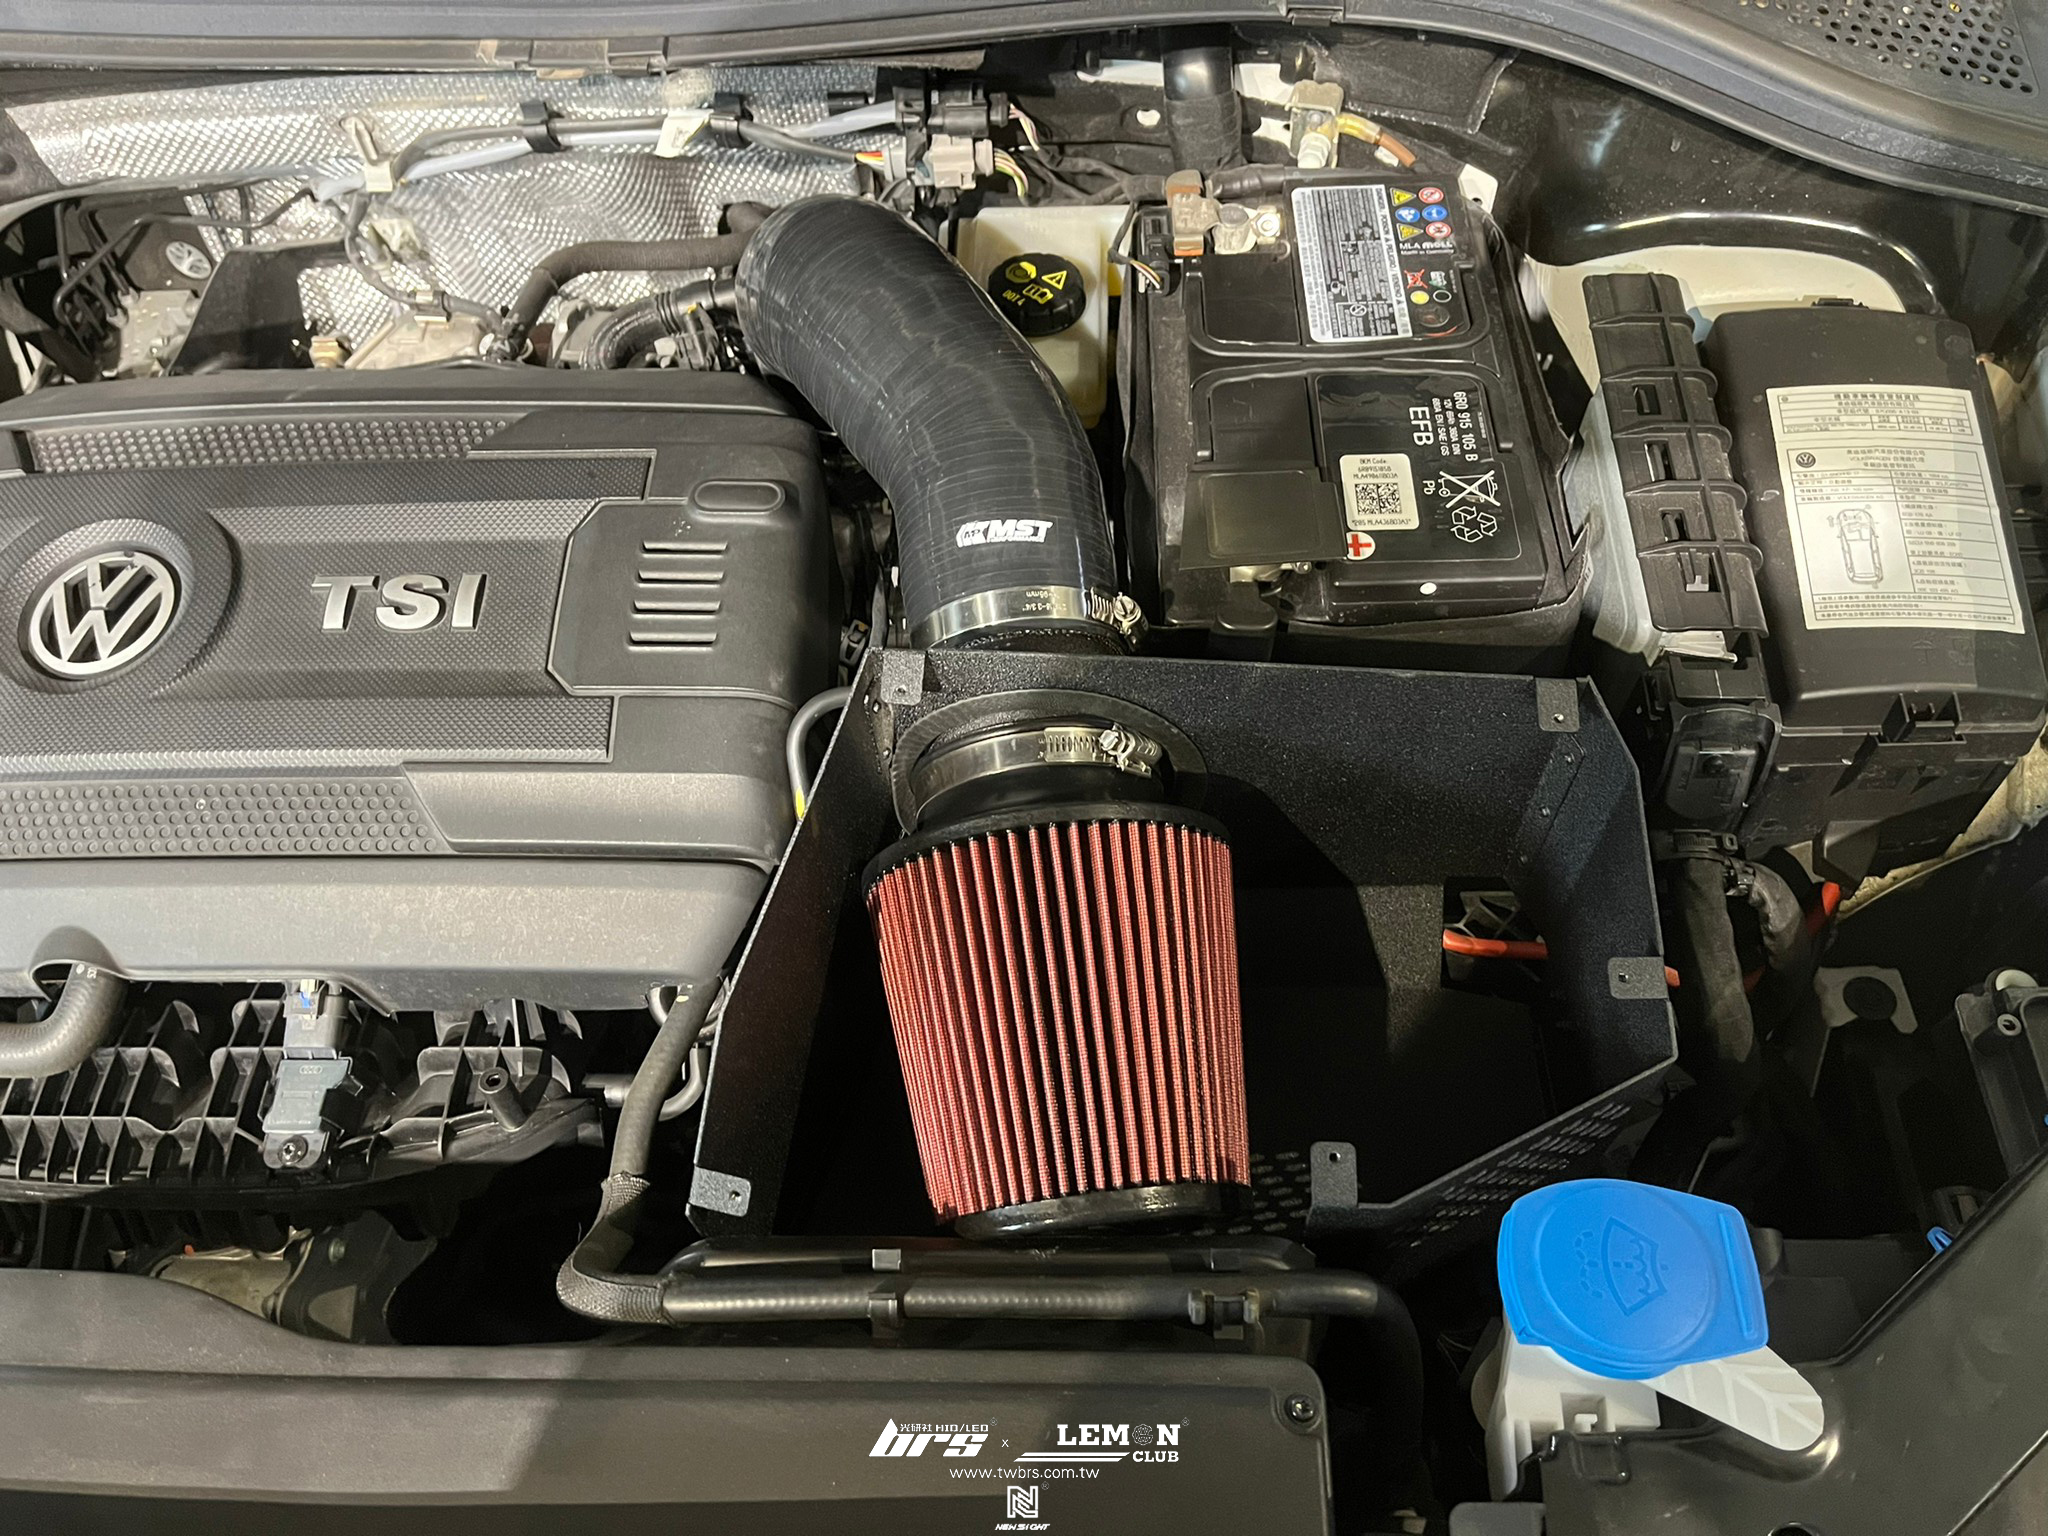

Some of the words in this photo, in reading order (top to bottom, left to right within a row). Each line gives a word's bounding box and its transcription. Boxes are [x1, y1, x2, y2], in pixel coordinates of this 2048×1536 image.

[1002, 289, 1020, 302] DOT
[1017, 298, 1026, 306] 4
[1409, 407, 1434, 446] EFB
[1444, 399, 1453, 409] 12V
[1452, 443, 1461, 455] DIN
[1457, 412, 1473, 429] 915
[1461, 433, 1477, 450] 105
[1465, 453, 1479, 462] B
[1422, 480, 1436, 495] Pb
[986, 519, 1054, 539] MST
[311, 573, 488, 632] TSI
